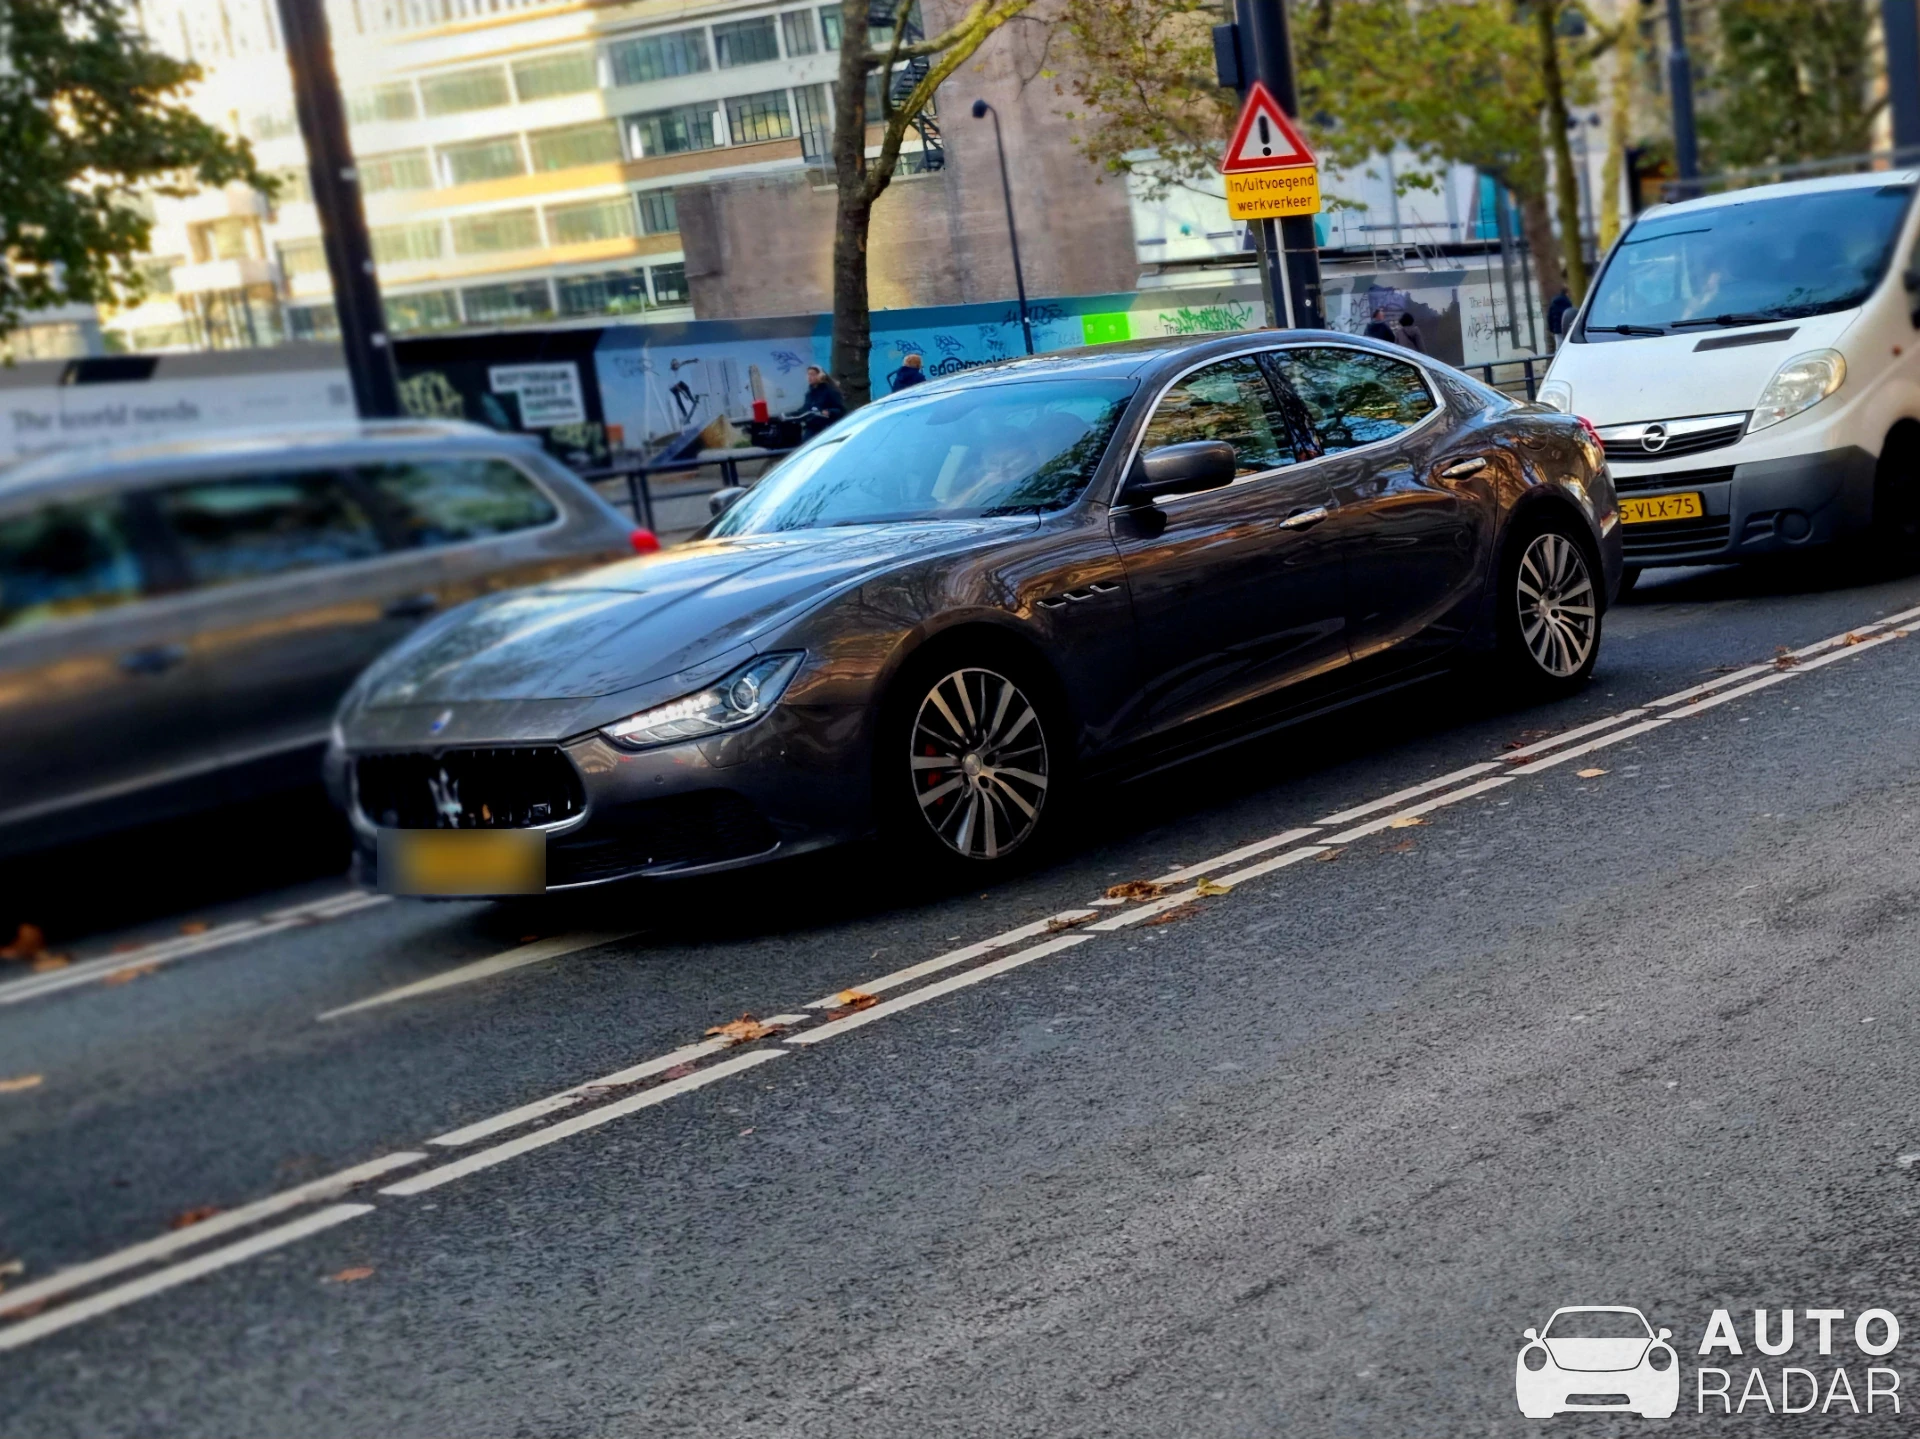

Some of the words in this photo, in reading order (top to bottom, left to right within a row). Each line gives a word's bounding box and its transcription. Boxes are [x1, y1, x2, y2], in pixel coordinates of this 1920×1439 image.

[1230, 174, 1314, 192] In/uitvoegend
[1238, 196, 1312, 211] werkverkeer
[1620, 498, 1694, 520] 5-VLX-75
